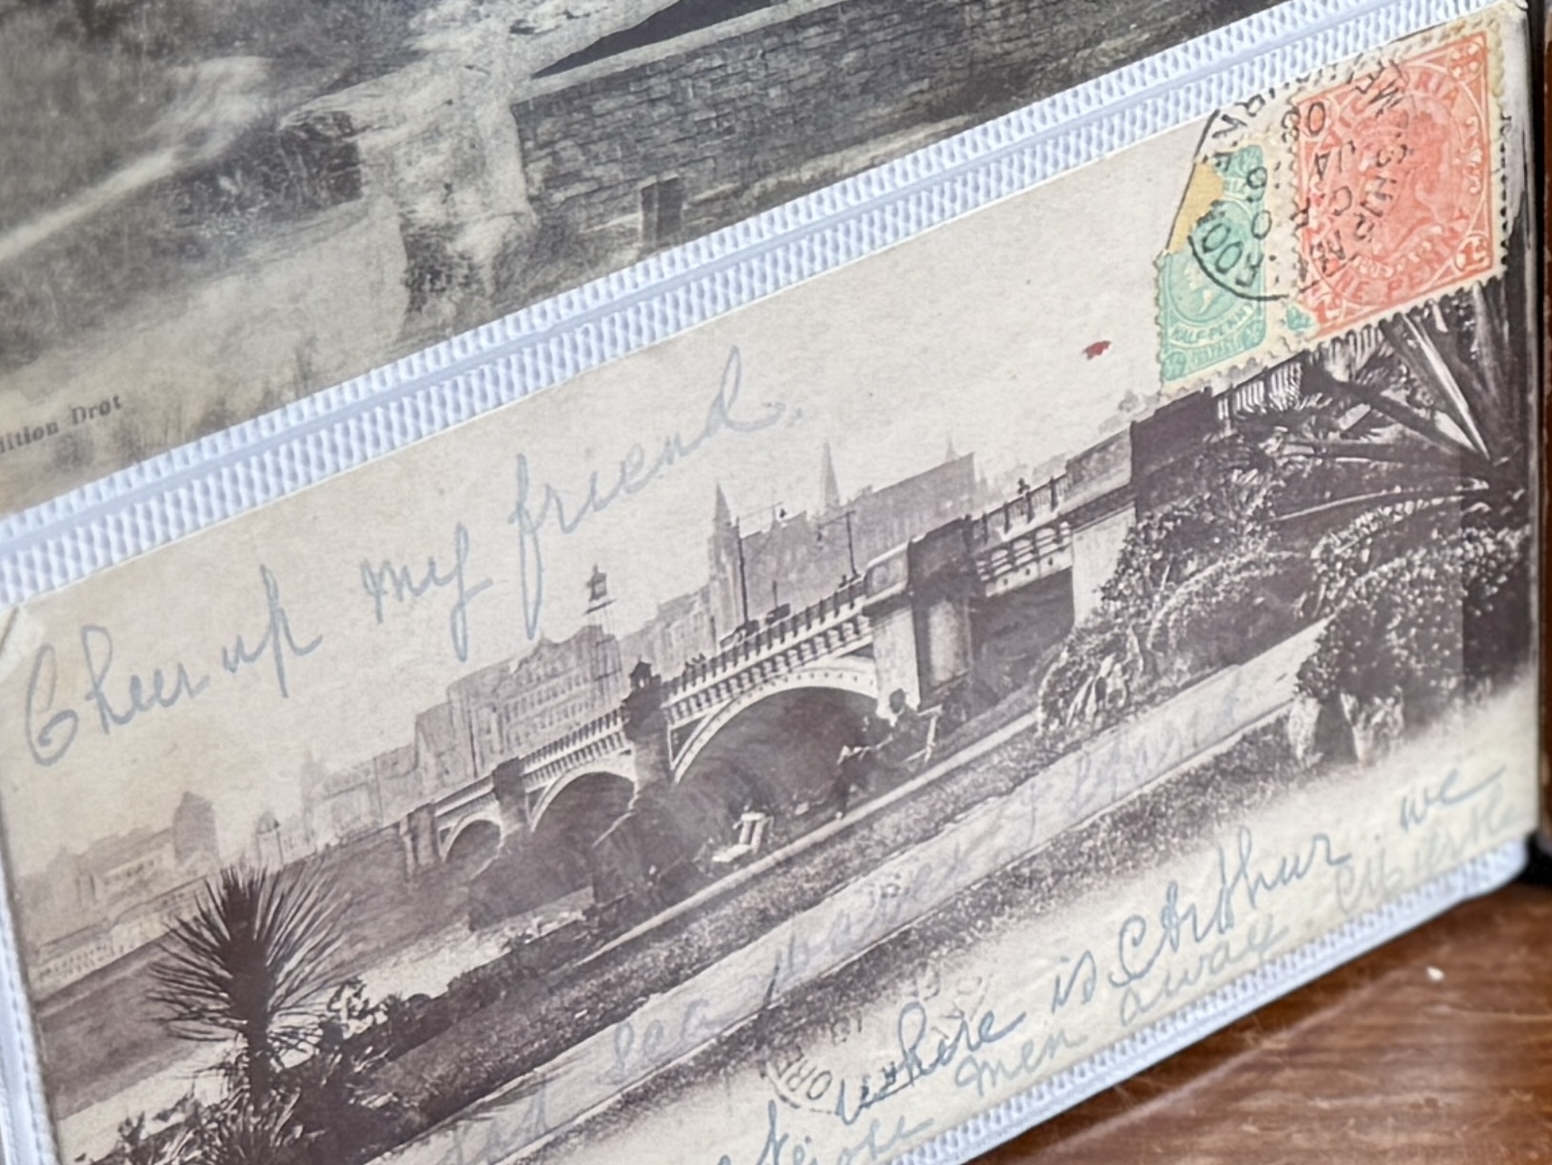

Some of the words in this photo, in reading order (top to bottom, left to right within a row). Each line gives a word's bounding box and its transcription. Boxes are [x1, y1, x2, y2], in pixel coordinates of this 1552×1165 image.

[24, 624, 213, 768] Cheer
[221, 563, 323, 699] up
[359, 522, 493, 663] my
[1050, 949, 1097, 1014] is
